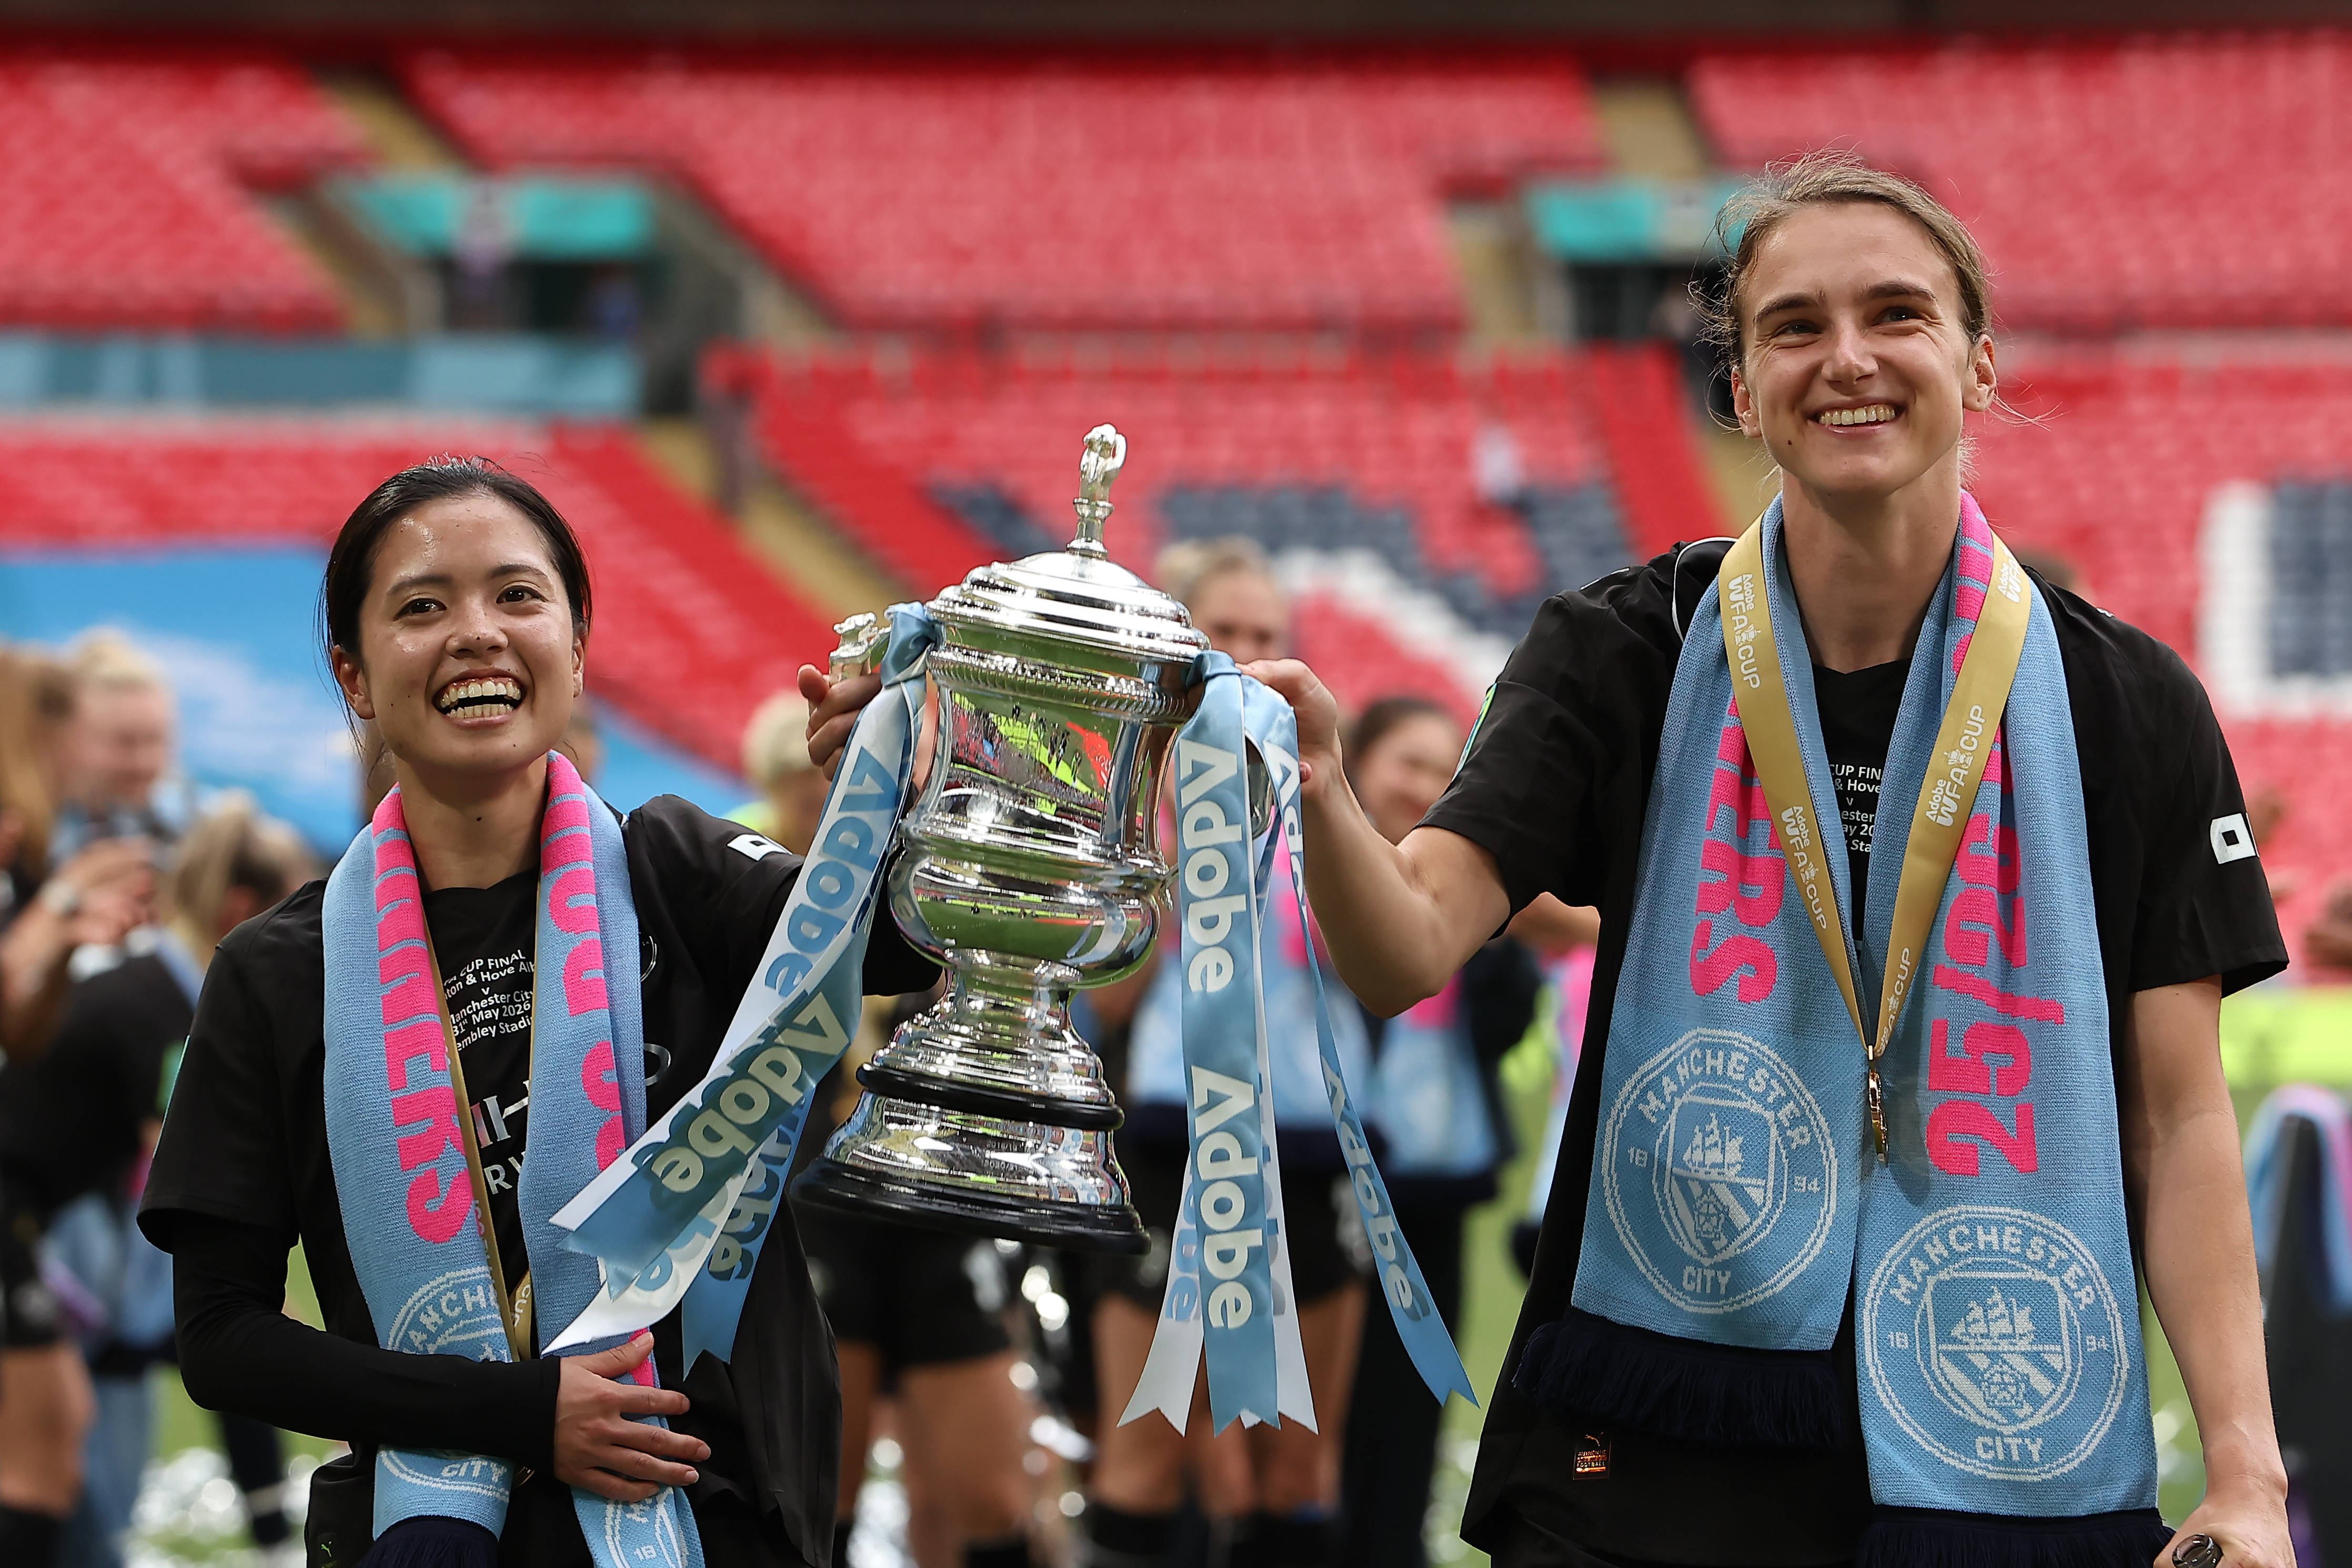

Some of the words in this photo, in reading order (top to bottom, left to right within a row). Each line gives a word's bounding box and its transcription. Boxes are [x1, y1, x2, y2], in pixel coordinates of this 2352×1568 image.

[1742, 573, 1755, 611] Adobe
[1997, 562, 2009, 596] Adobe
[1728, 575, 1748, 631] WFA
[1737, 644, 1761, 689] CUP
[1858, 767, 1882, 780] FIN
[1936, 767, 1968, 827] WFA
[1959, 704, 1986, 752] CUP
[1834, 778, 1843, 790] &
[1847, 779, 1881, 793] Hove
[1846, 797, 1854, 806] v
[1925, 779, 1947, 822] Adobe
[1793, 806, 1811, 847] Adobe
[1842, 810, 1875, 823] ester
[1842, 823, 1857, 836] ay
[1850, 839, 1872, 852] Sta
[765, 747, 899, 997] Adobe
[1179, 739, 1247, 993] Adobe
[1781, 807, 1808, 869] WFA
[1806, 883, 1827, 930] CUP
[460, 959, 484, 977] CUP
[487, 949, 526, 970] FINAL
[466, 973, 477, 986] &
[480, 966, 515, 982] Hove
[1894, 947, 1911, 996] CUP
[481, 987, 490, 996] v
[471, 1008, 499, 1025] May
[502, 1000, 531, 1017] 2026
[456, 1026, 496, 1052] embley
[498, 1015, 533, 1034] Stadi
[650, 993, 849, 1193] Adobe
[1637, 1049, 1811, 1150] MANCHESTER
[1191, 1064, 1263, 1329] Adobe
[1794, 1175, 1821, 1193] 94
[1683, 1265, 1732, 1294] CITY
[1889, 1224, 2096, 1311] MANCHESTER
[1887, 1331, 1909, 1350] 18
[2086, 1334, 2109, 1351] 94
[1975, 1436, 2044, 1462] CITY
